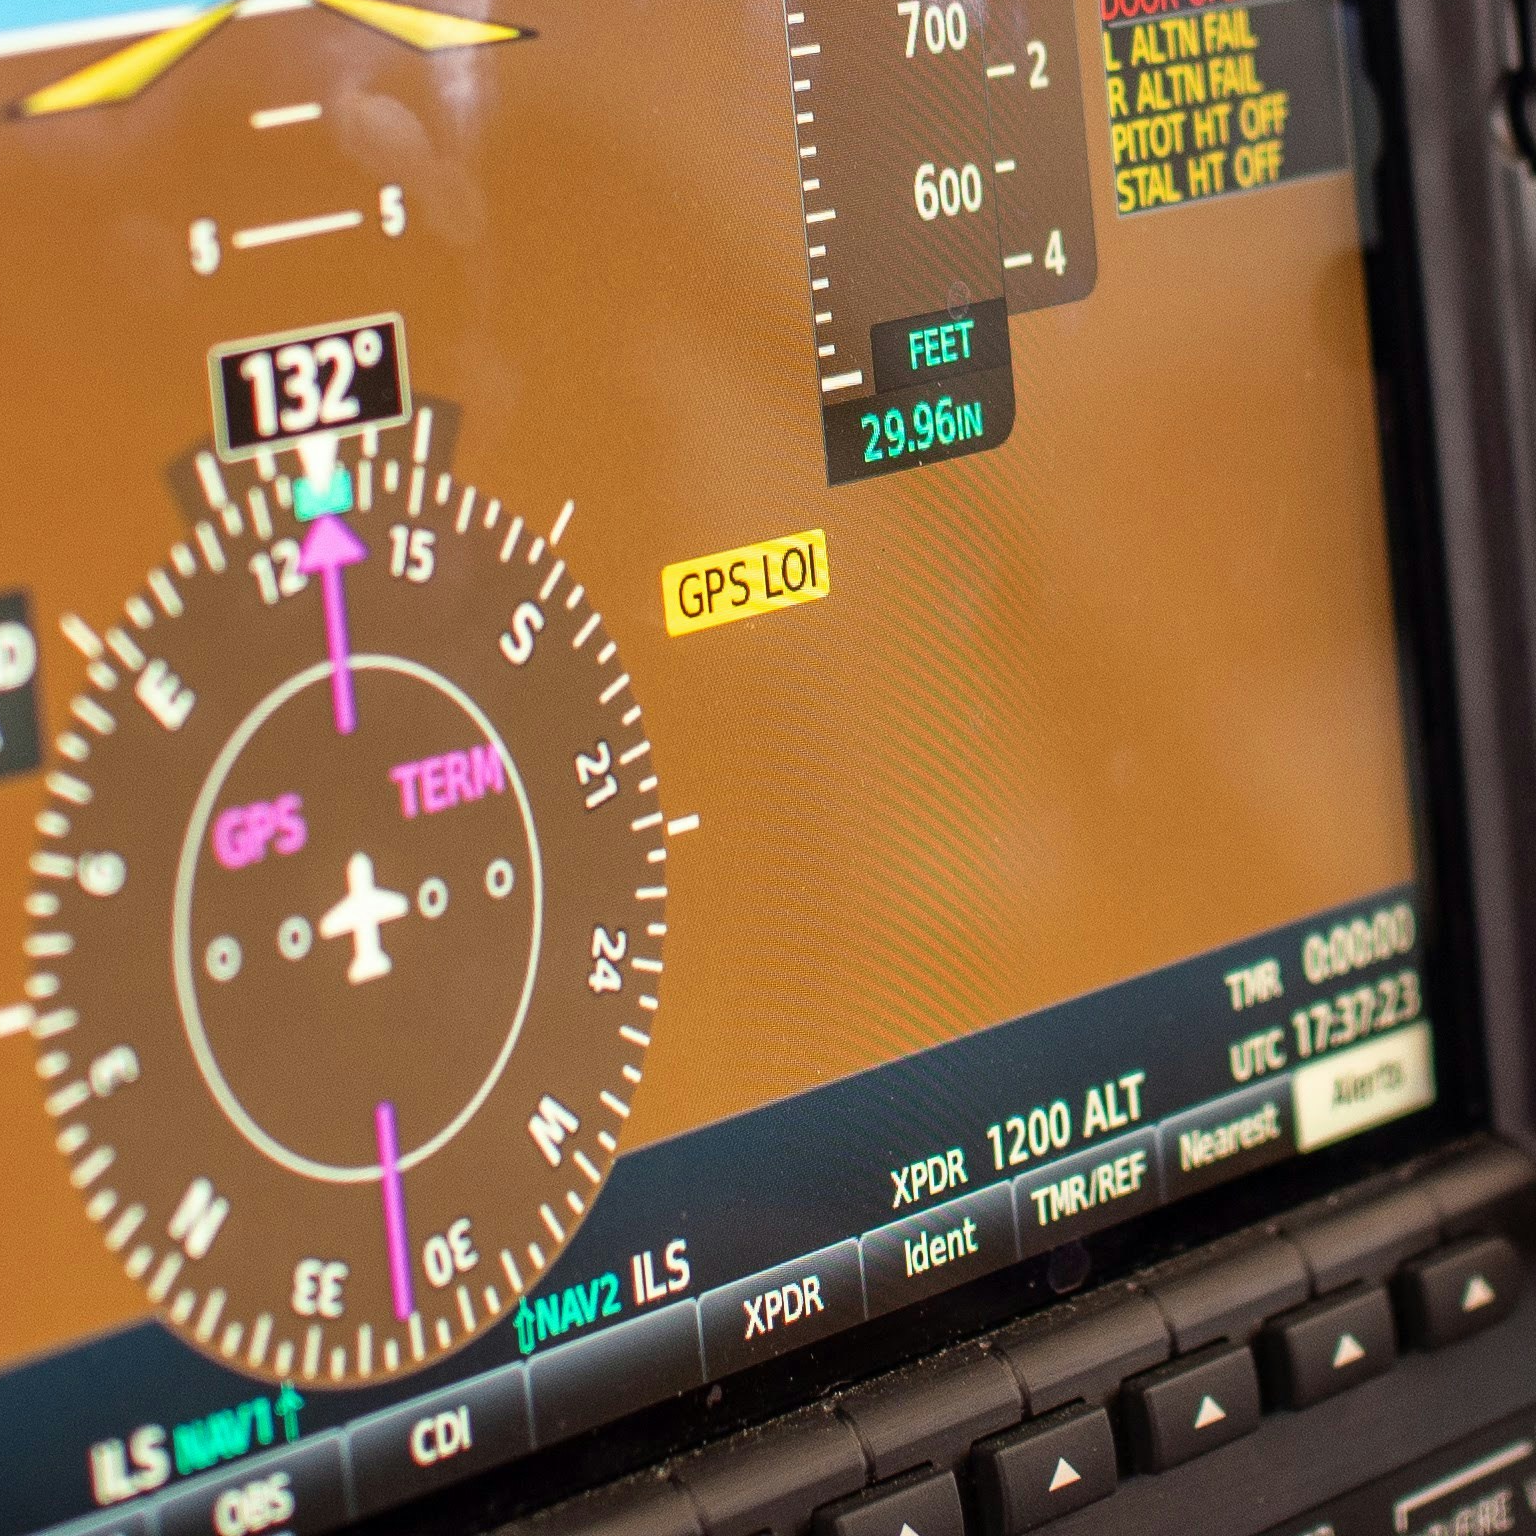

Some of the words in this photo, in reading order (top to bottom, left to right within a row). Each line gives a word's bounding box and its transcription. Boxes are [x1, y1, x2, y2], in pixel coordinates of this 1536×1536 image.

[897, 1, 967, 58] 700
[1104, 31, 1121, 72] L
[1131, 19, 1200, 68] ALTN
[1203, 9, 1258, 53] FAIL
[1027, 40, 1048, 89] 2
[1108, 78, 1128, 117] R
[1137, 64, 1205, 113] ALTN
[1209, 55, 1263, 98] FAIL
[1112, 114, 1186, 164] PITOT
[1194, 103, 1232, 149] HT
[1240, 91, 1289, 141] OFF
[914, 163, 983, 220] 600
[1116, 162, 1182, 212] STAL
[1187, 151, 1227, 197] HT
[1234, 141, 1283, 188] OFF
[379, 185, 406, 237] 5
[189, 219, 220, 275] 5
[1044, 230, 1066, 276] 4
[908, 319, 974, 370] FEET
[242, 328, 383, 437] 132°
[248, 539, 309, 605] 12
[389, 525, 434, 583] 15
[678, 561, 751, 622] GPS
[760, 544, 818, 601] LOI
[500, 603, 545, 664] S
[134, 659, 195, 730] E
[212, 792, 308, 868] GPS
[389, 744, 505, 817] TERM
[575, 742, 617, 808] 21
[588, 926, 626, 994] 24
[1224, 959, 1284, 1012] TMR
[1302, 903, 1415, 984] 0:00:00
[1229, 1029, 1288, 1082] UTC
[1291, 969, 1421, 1058] 17:37:23
[528, 1096, 580, 1165] W
[890, 1147, 969, 1209] XPDR
[986, 1100, 1070, 1170] 1200
[1083, 1072, 1145, 1138] ALT
[1180, 1101, 1282, 1172] Nearest
[1030, 1151, 1149, 1226] TMR/REF
[422, 1218, 478, 1287] 30
[904, 1217, 979, 1278] Ident
[292, 1259, 347, 1318] 33
[534, 1273, 622, 1340] NAV2
[630, 1239, 691, 1306] ILS
[743, 1274, 825, 1340] XPDR
[87, 1424, 171, 1505] ILS
[172, 1396, 273, 1475] NAV1
[410, 1405, 473, 1467] CDI
